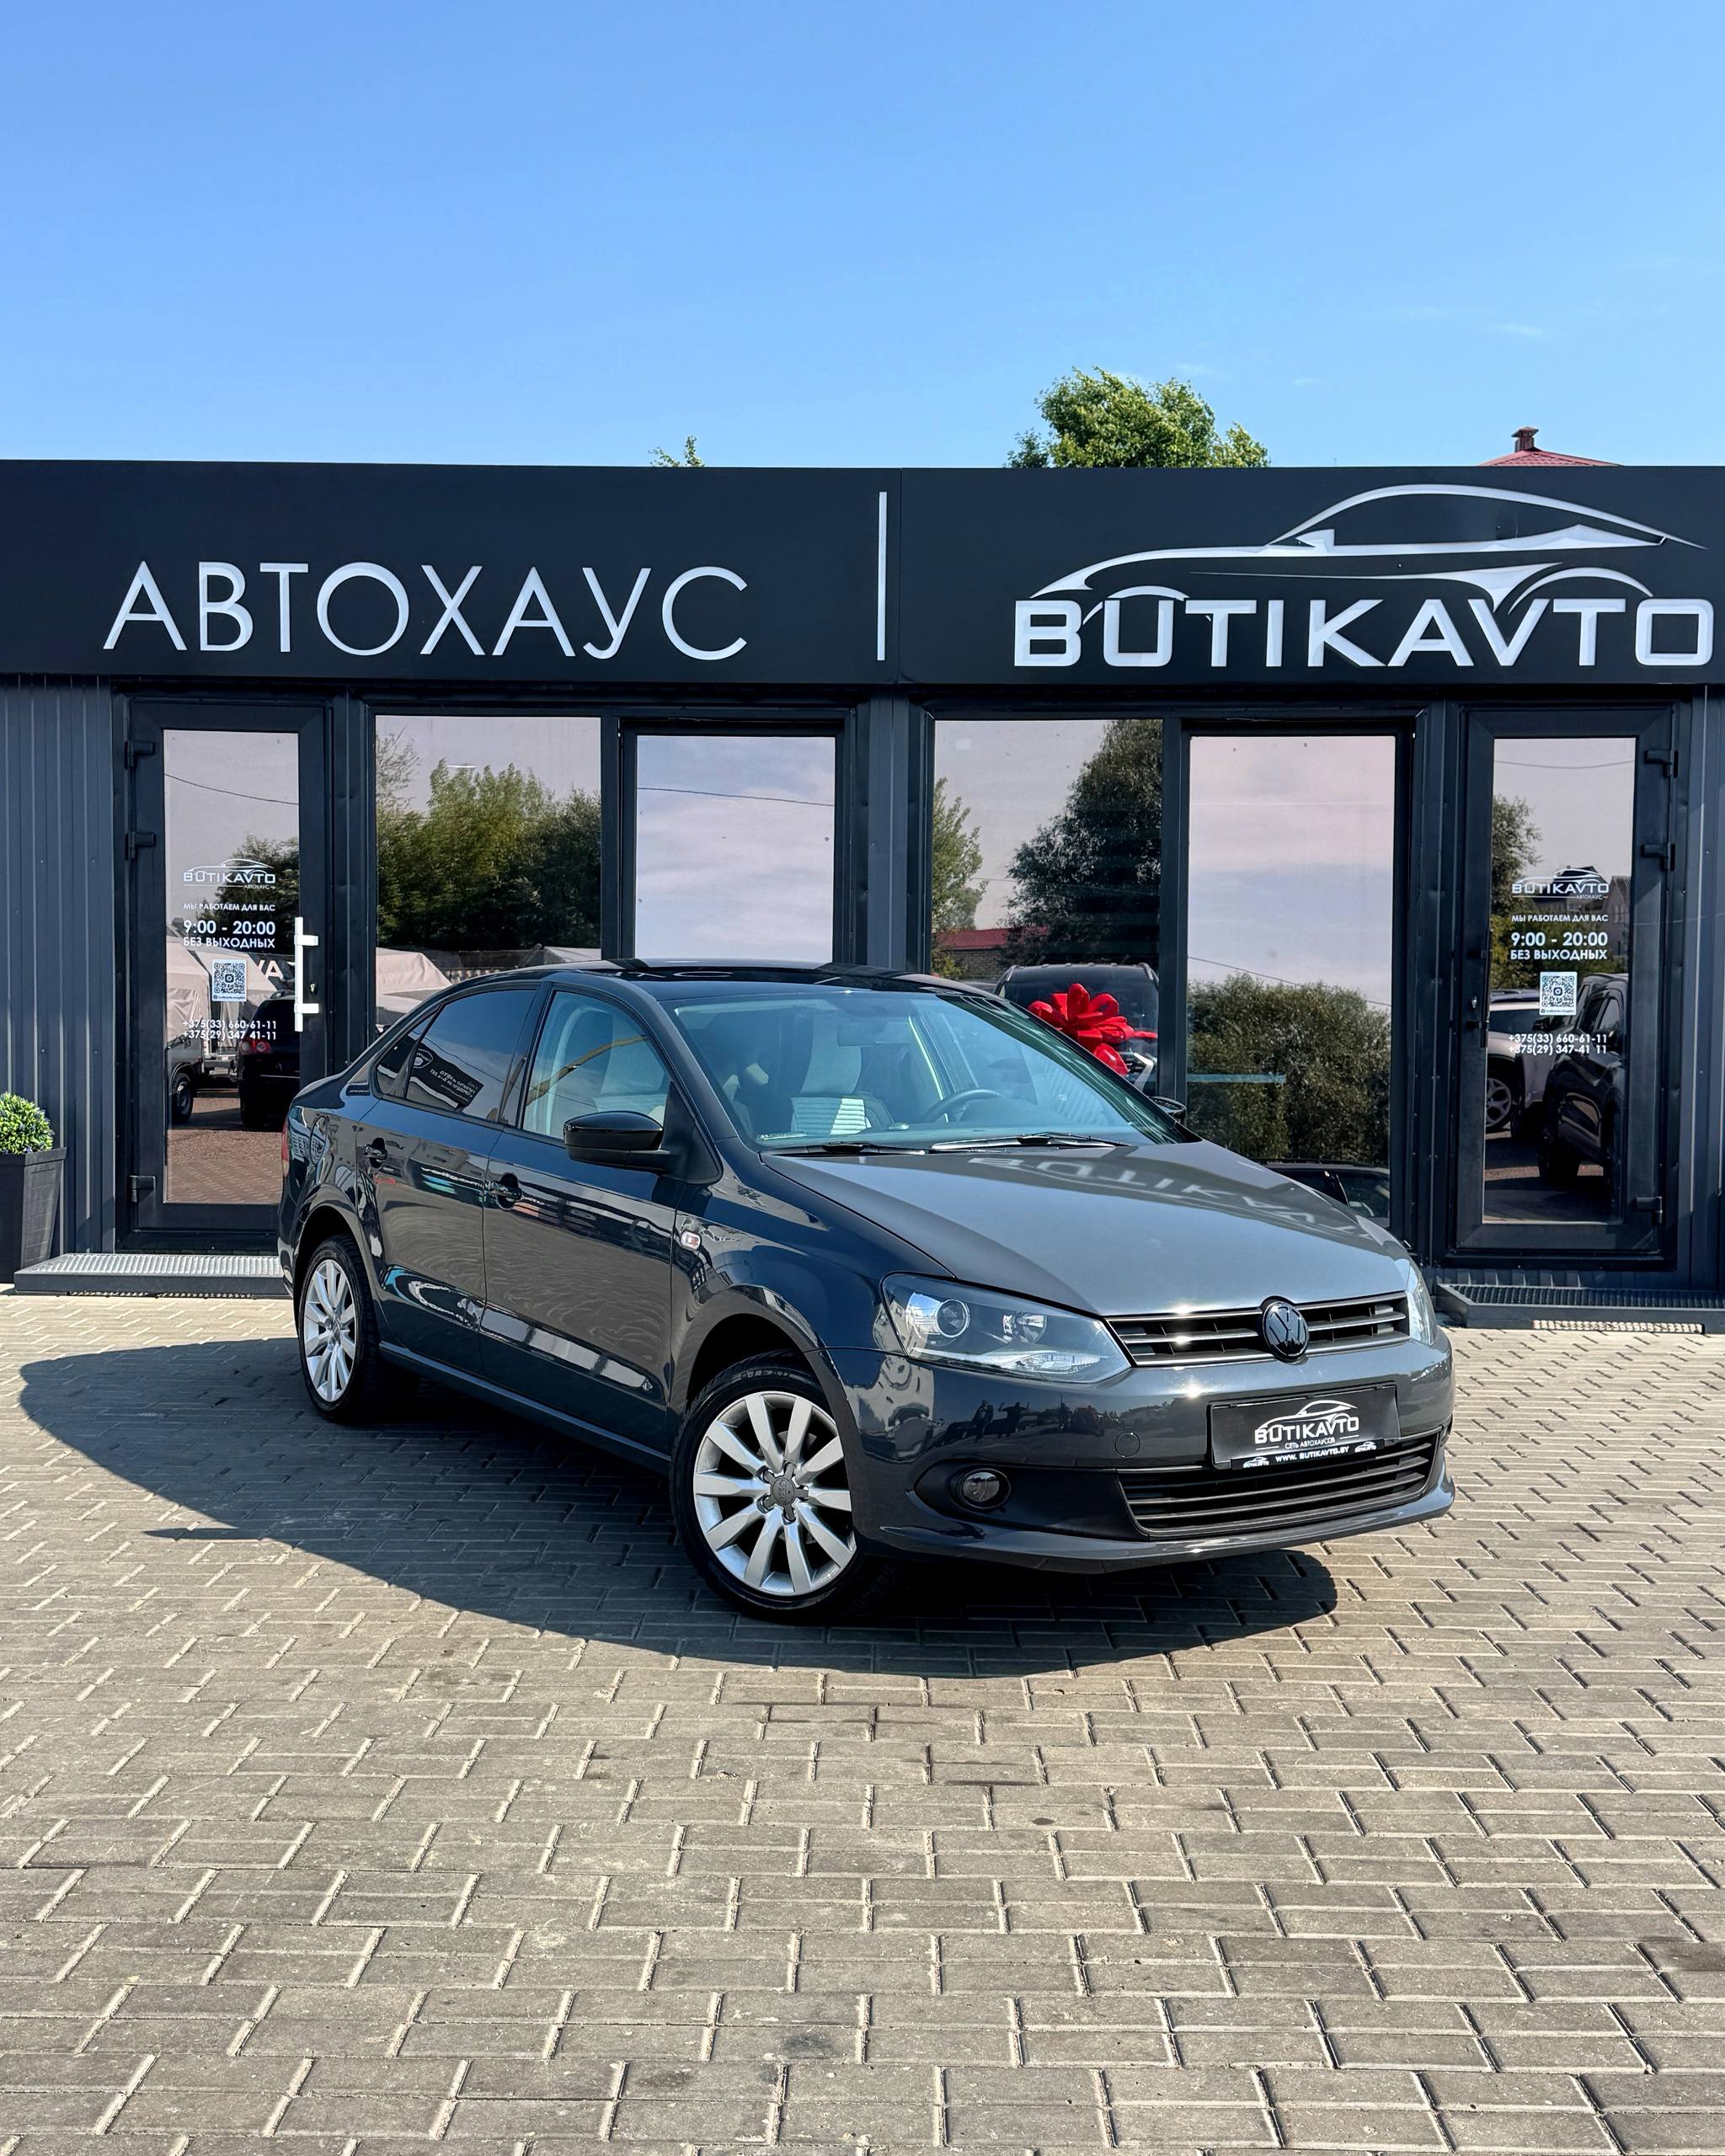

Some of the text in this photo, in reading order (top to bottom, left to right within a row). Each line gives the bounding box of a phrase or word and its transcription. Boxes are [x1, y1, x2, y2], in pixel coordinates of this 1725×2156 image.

[103, 560, 747, 660] АВТОХАУС
[1013, 592, 1714, 668] BUTIKAVTO
[184, 871, 275, 883] BUTIKAVTO
[1512, 883, 1609, 894] BUTIKAVTO
[184, 920, 216, 934] 9:00
[232, 921, 275, 935] 20:00
[184, 937, 275, 948] БЕЗ ВЫХОДНЫХ
[1510, 931, 1546, 947] 9:00
[1562, 931, 1609, 947] 20:00
[1510, 949, 1607, 961] БЕЗ ВЫХОДНЫХ
[183, 1019, 276, 1031] +375(33) 660-61-11
[183, 1030, 225, 1041] +375(29)
[1509, 1033, 1607, 1044] +375(33) 660-61-11
[1509, 1044, 1553, 1055] +375(29)
[1255, 1417, 1359, 1444] BUTIKAVTO
[1300, 1437, 1335, 1448] АВТОХАУСОВ
[1299, 1446, 1349, 1460] BUTIKAVTO.BY
